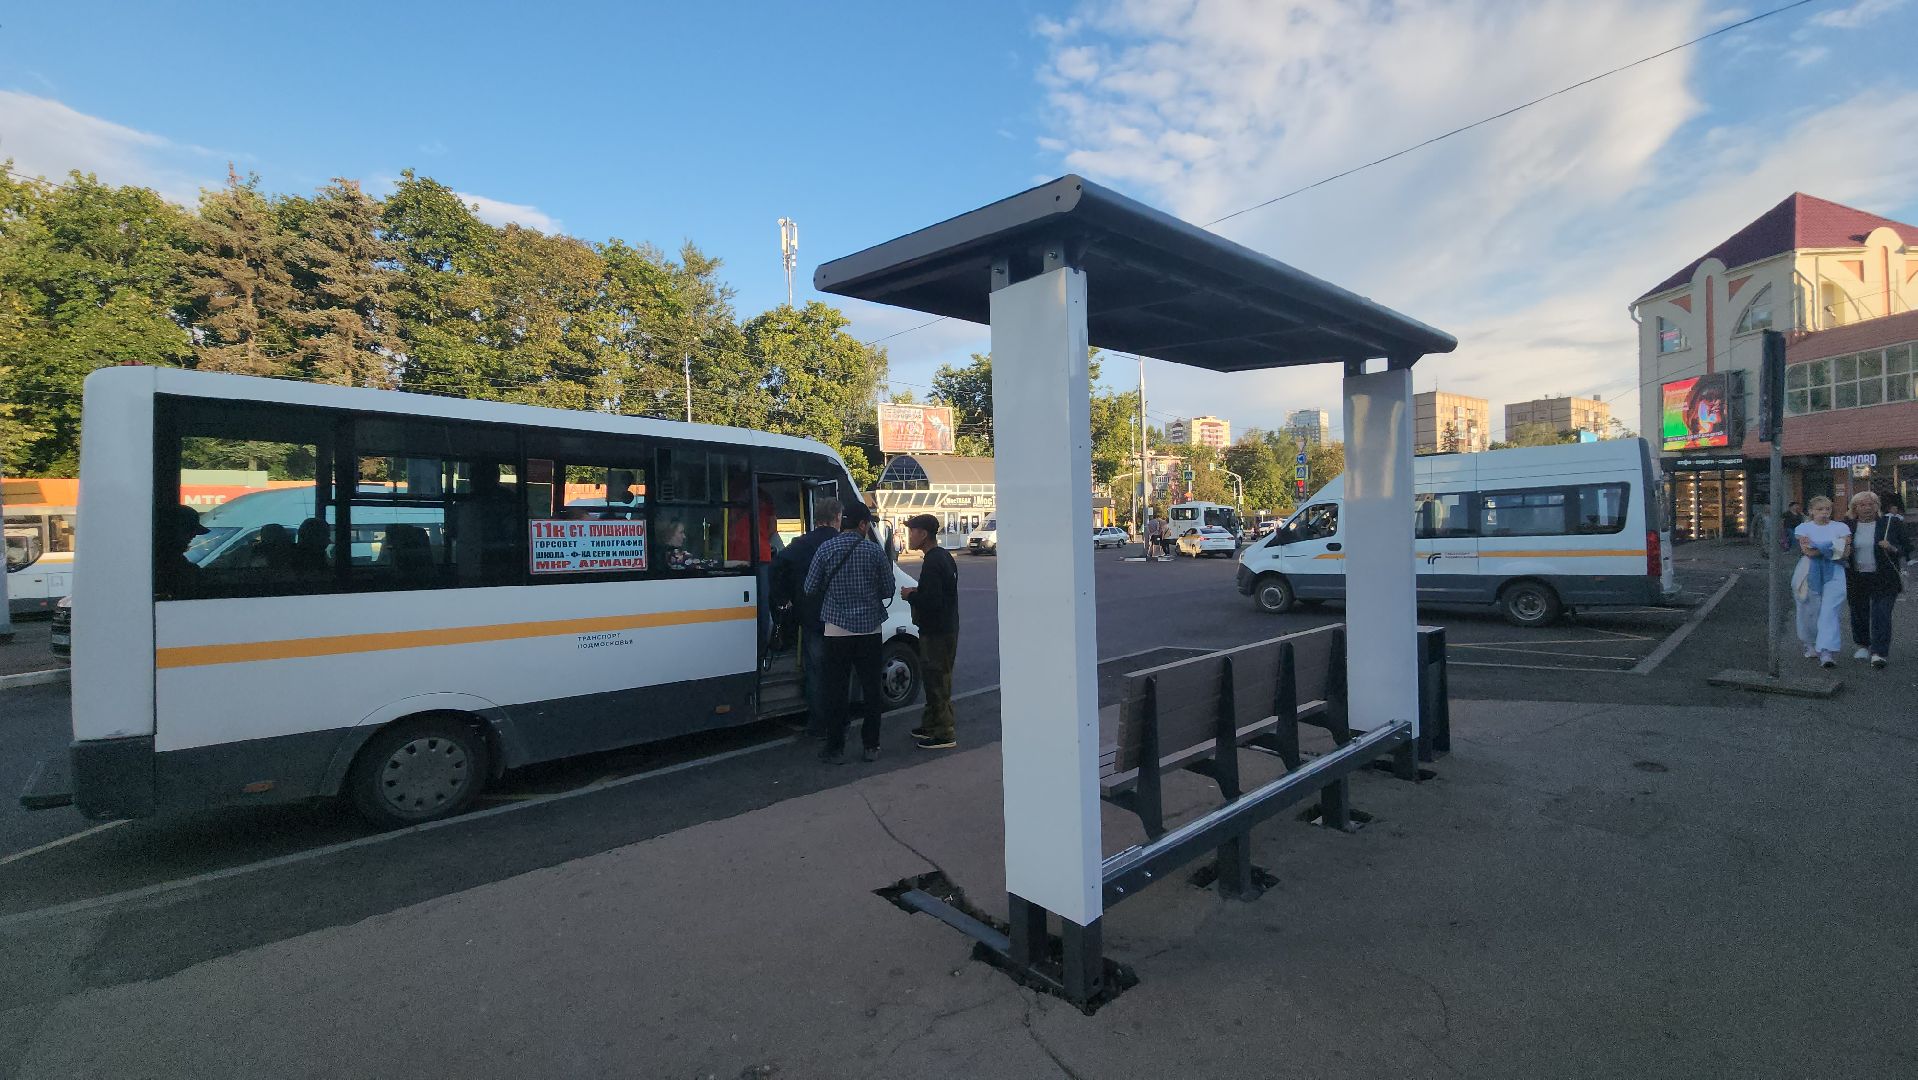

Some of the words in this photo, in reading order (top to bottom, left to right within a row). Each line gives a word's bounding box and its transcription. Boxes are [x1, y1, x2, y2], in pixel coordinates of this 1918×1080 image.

[569, 524, 587, 537] СТ.
[589, 524, 644, 537] ПУШКИНО
[535, 540, 578, 548] ГОРСОВЕТ
[591, 539, 643, 547] ТИПОГРАФИЯ
[535, 551, 565, 559] ШКОЛА
[579, 558, 644, 569] АРМАНД
[577, 632, 621, 642] ТРАНСПОРТ
[577, 639, 633, 649] ПОДМОСКОВЬЯ
